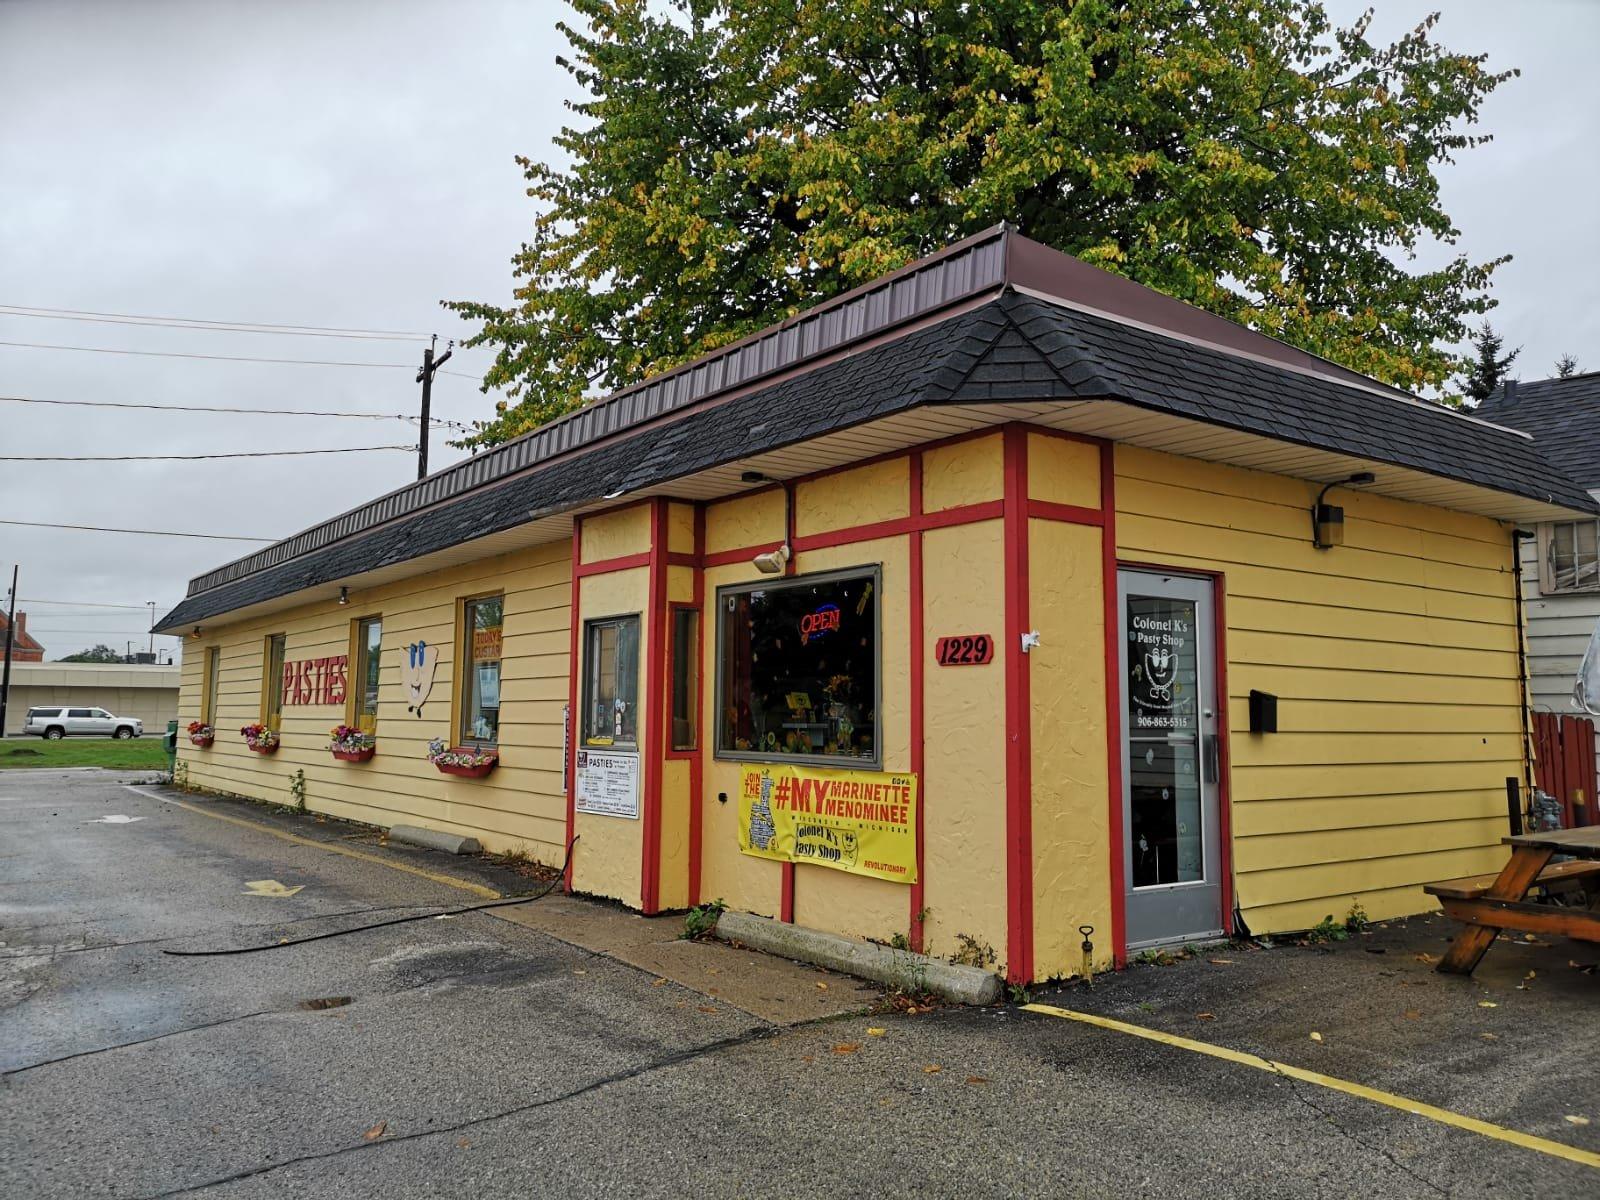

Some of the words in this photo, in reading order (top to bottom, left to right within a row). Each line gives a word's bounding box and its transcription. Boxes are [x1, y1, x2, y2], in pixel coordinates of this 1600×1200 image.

[801, 609, 841, 634] OPEN
[1133, 616, 1172, 631] Colonel
[1174, 618, 1188, 633] K's
[1137, 632, 1161, 646] Pasty
[1162, 635, 1184, 648] Shop
[474, 645, 502, 658] CUSTAR
[940, 636, 987, 664] 1229
[283, 655, 348, 705] PASTIES
[589, 758, 613, 768] PASTIES
[745, 772, 761, 783] JOIN
[744, 783, 760, 795] THE
[831, 780, 910, 804] MARINETTE
[825, 798, 908, 824] MENOMINEE
[798, 825, 824, 838] olonel
[826, 829, 839, 847] K's
[818, 845, 841, 862] Shop
